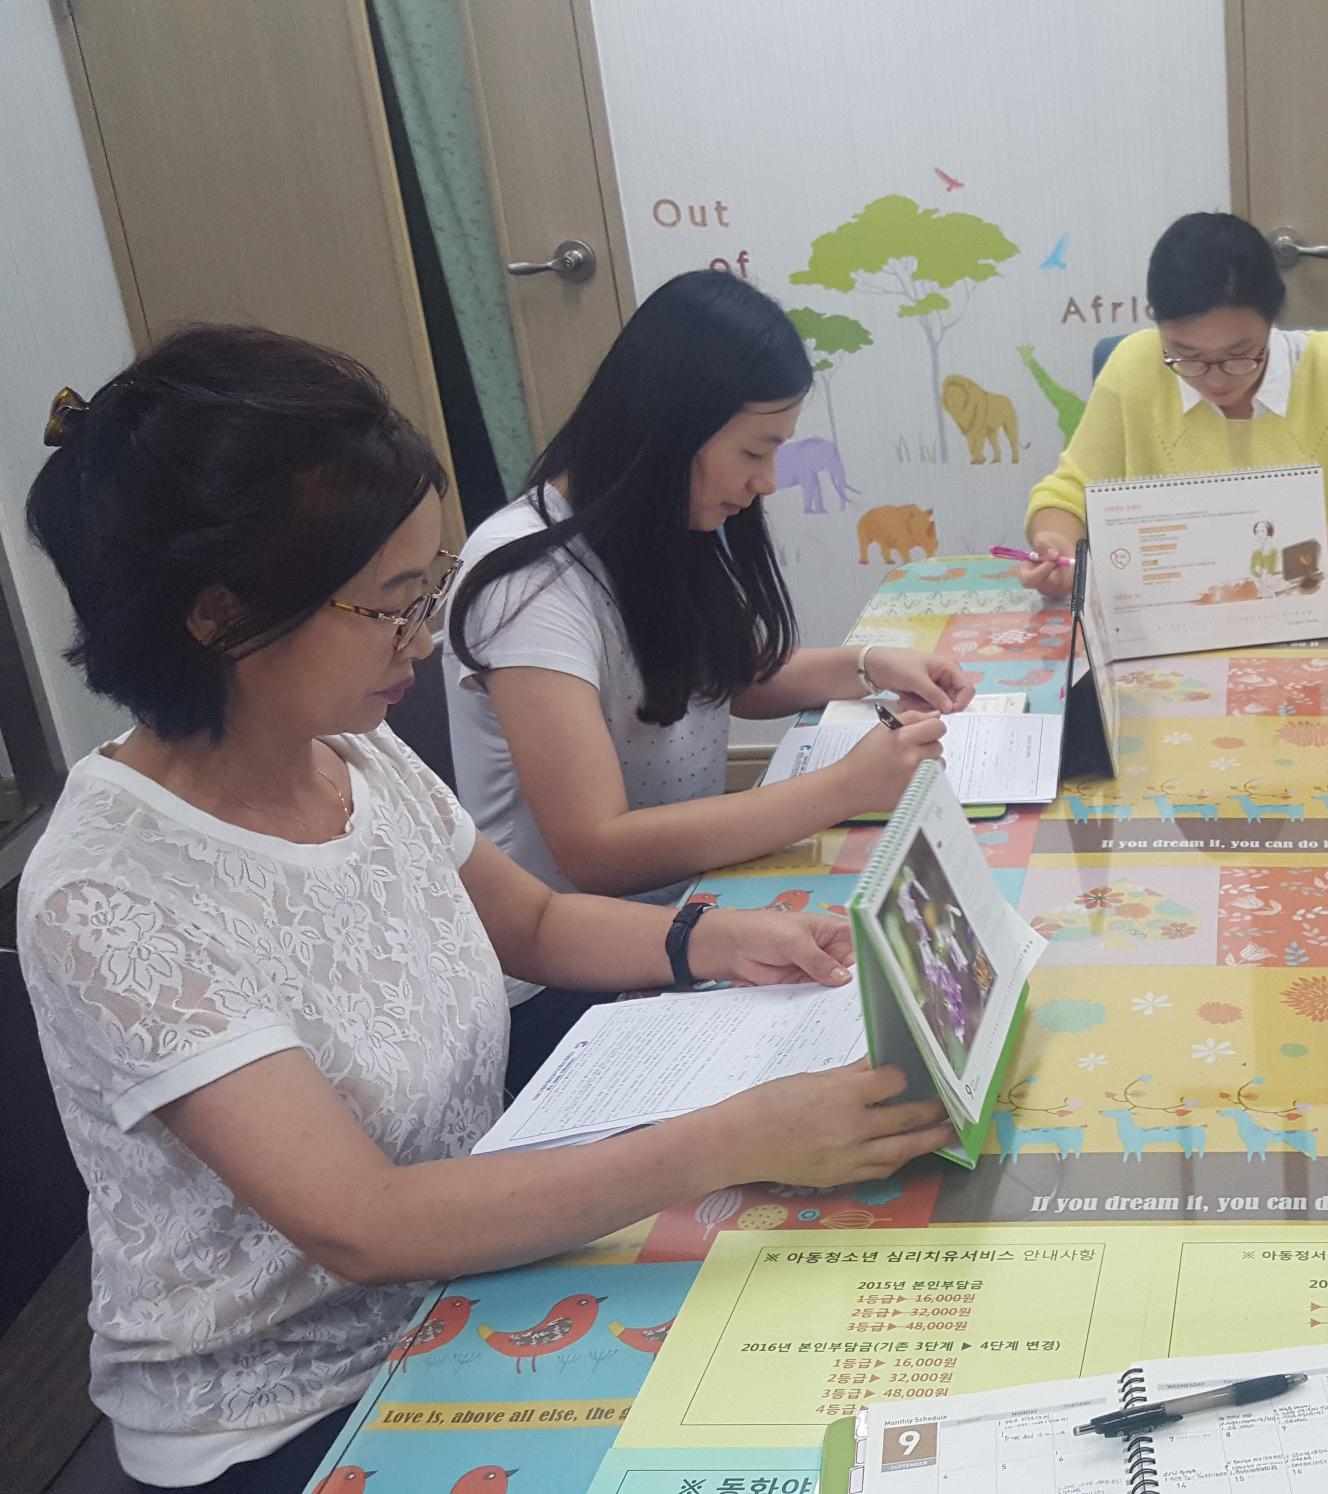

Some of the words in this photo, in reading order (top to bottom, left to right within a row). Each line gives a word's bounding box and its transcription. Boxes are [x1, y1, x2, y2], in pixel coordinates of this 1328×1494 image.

[652, 198, 730, 228] Out
[1061, 294, 1156, 324] Afric
[1102, 839, 1113, 849] If
[1118, 840, 1148, 850] you
[1152, 839, 1203, 849] dream
[1230, 840, 1260, 850] you
[1265, 840, 1293, 849] can
[1298, 839, 1318, 849] do
[1030, 1196, 1051, 1212] If
[1056, 1198, 1098, 1214] you
[1104, 1195, 1179, 1212] dream
[1216, 1197, 1259, 1213] you
[1266, 1196, 1308, 1212] can
[787, 1251, 879, 1264] 아동청소년
[886, 1249, 1014, 1264] 심리치유서비스
[1023, 1248, 1097, 1262] 안내사항
[857, 1280, 905, 1290] 2015년
[912, 1280, 985, 1291] 본인부담금
[914, 1293, 976, 1304] 16,000원
[910, 1307, 972, 1318] 32,000원
[905, 1321, 968, 1332] 48,000원
[741, 1342, 792, 1353] 2016년
[915, 1341, 954, 1352] 3단계
[979, 1341, 1019, 1352] 4단계
[1025, 1341, 1062, 1352] 변경)
[832, 1358, 873, 1369] 1등급
[893, 1357, 958, 1369] 16,000원
[827, 1373, 868, 1384] 2등급
[888, 1373, 954, 1384] 32,000원
[821, 1388, 864, 1400] 3등급
[882, 1388, 948, 1400] 48,000원
[382, 1409, 424, 1424] Love
[451, 1409, 505, 1424] above
[508, 1408, 536, 1423] all
[538, 1408, 578, 1423] else,
[585, 1407, 615, 1421] the
[619, 1405, 632, 1421] g
[815, 1403, 859, 1416] 4등급
[884, 1416, 914, 1427] Monthly
[914, 1414, 948, 1424] Schedule
[899, 1430, 921, 1456] 9
